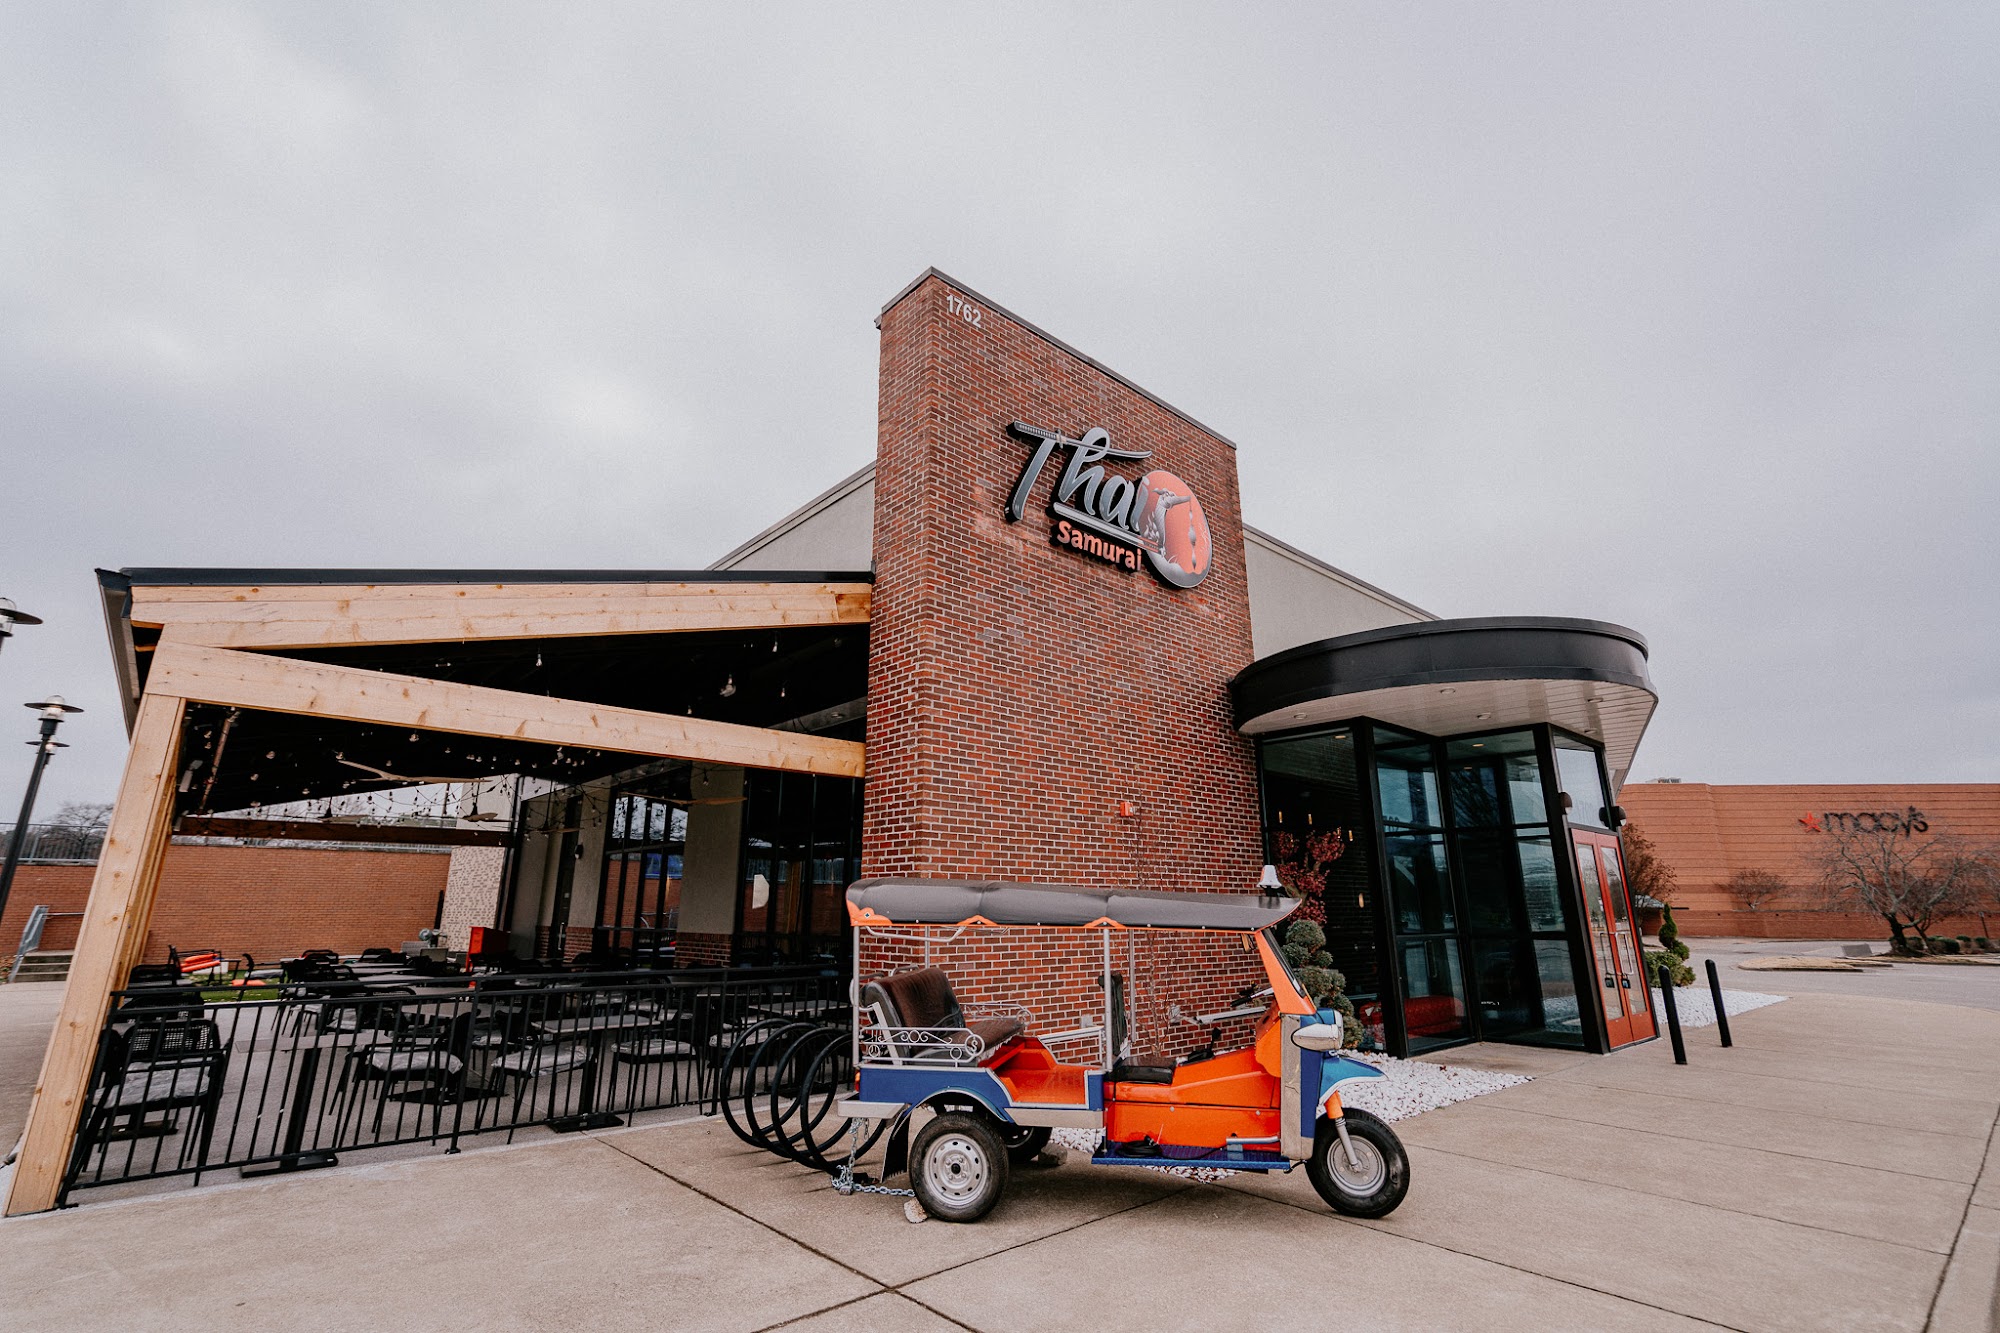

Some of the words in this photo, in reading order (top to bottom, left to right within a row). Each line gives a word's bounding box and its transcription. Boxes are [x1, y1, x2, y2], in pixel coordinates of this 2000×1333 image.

[946, 294, 982, 328] 1762
[1008, 420, 1153, 533] Thai
[1057, 521, 1143, 571] Samurai
